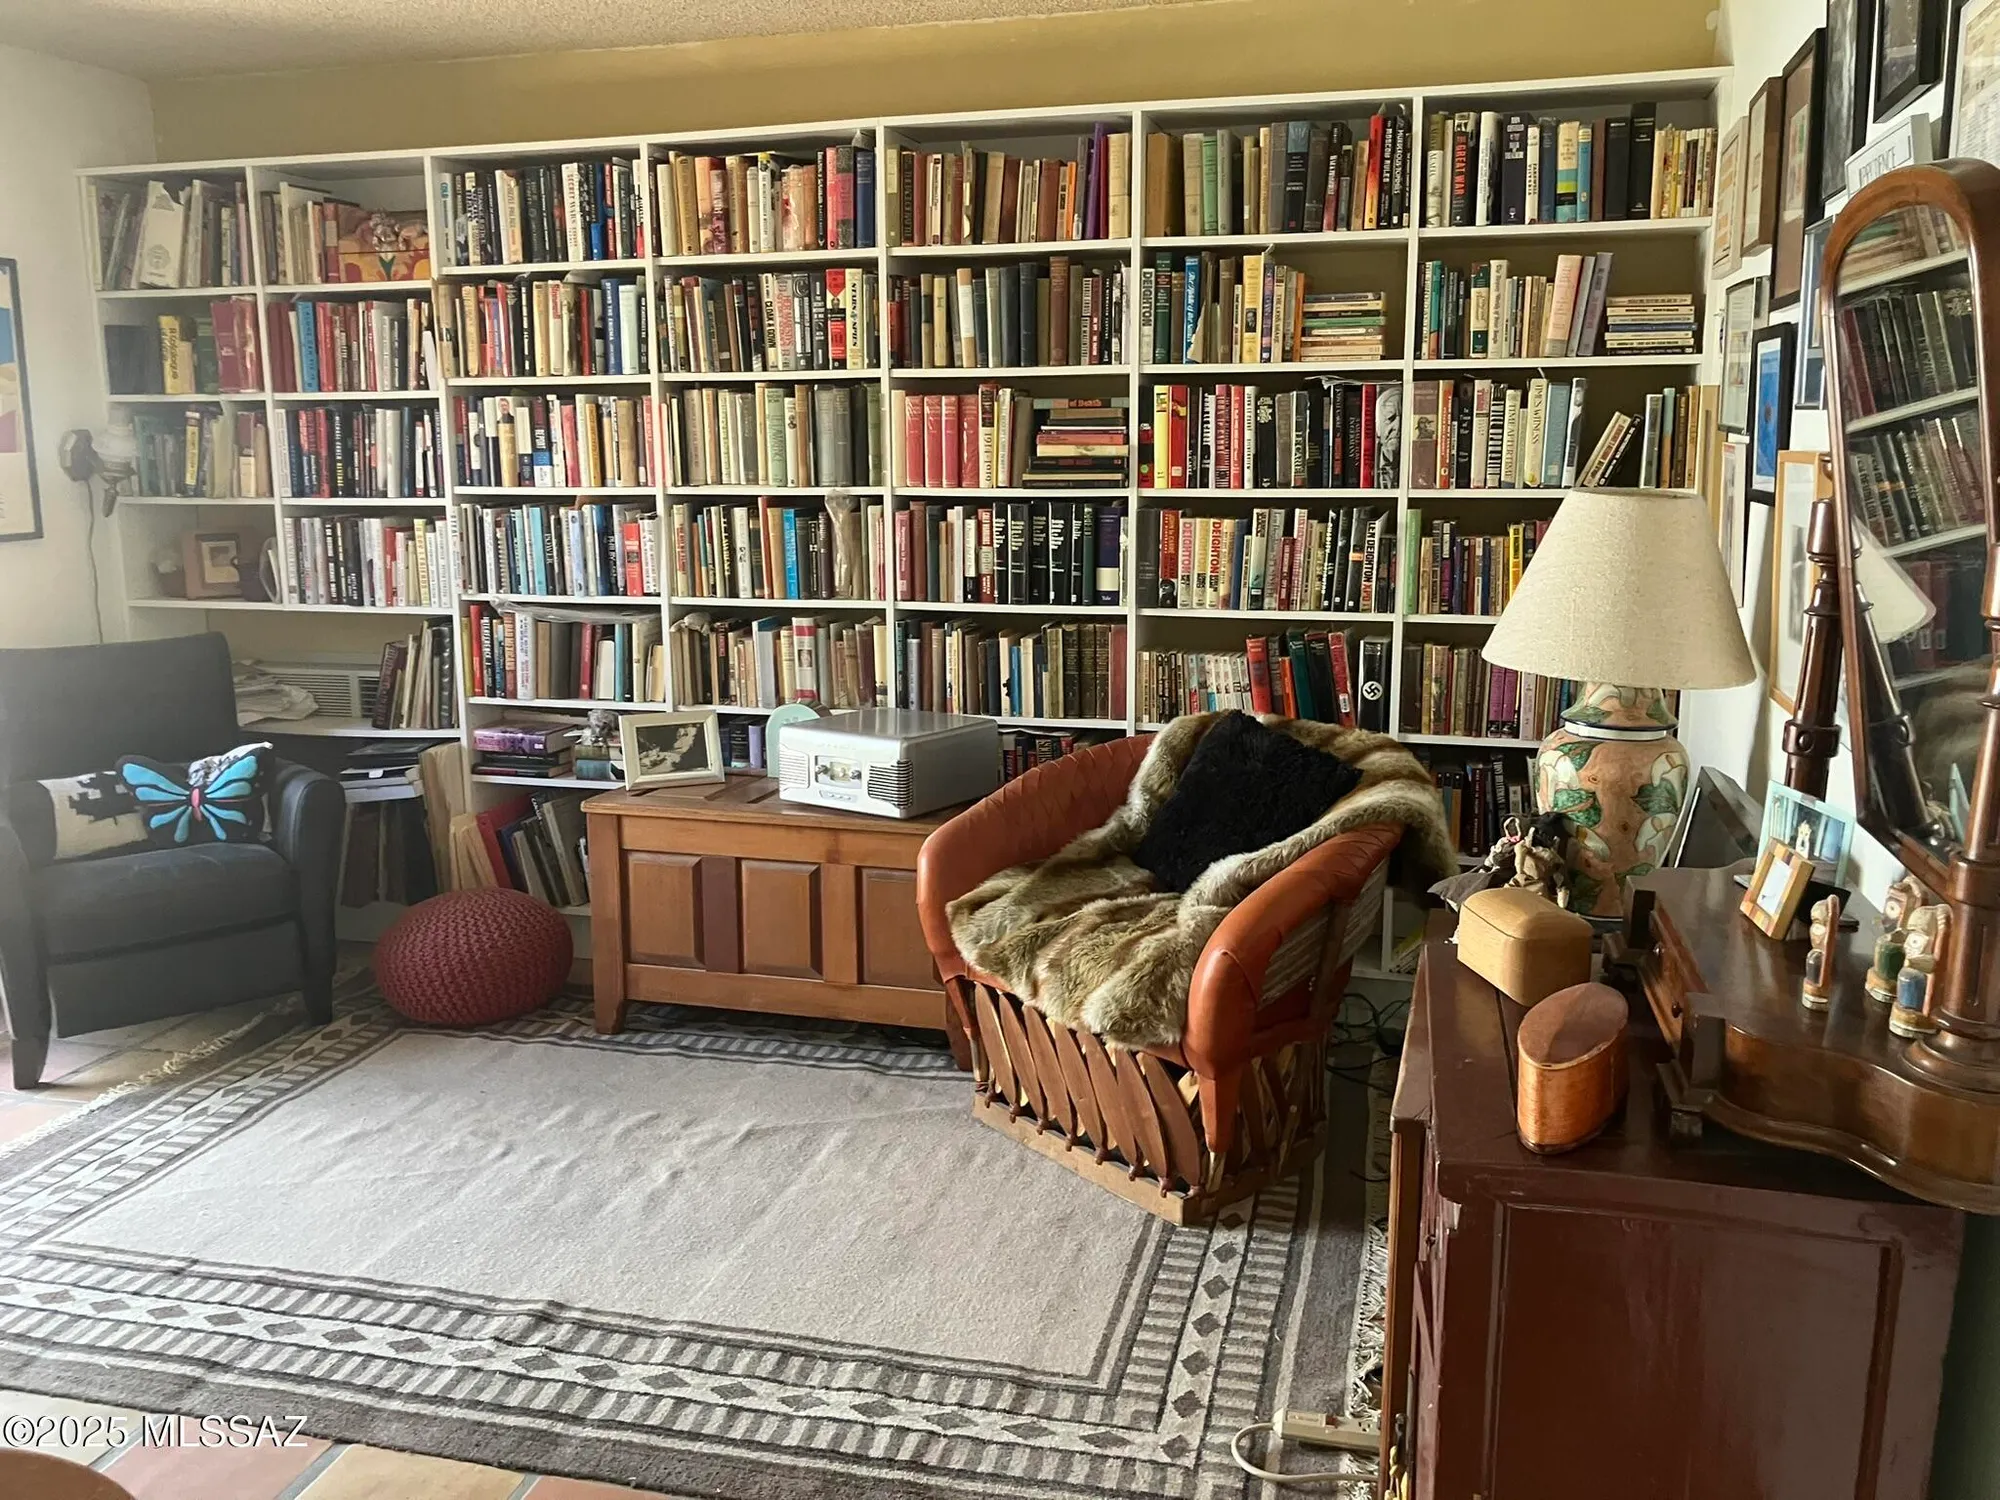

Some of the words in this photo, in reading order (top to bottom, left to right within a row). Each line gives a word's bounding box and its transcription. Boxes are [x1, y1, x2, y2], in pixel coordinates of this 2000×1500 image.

[1455, 144, 1467, 172] GREAT
[1454, 174, 1467, 195] WAR
[1143, 271, 1154, 327] DEIGHTON
[535, 429, 547, 449] REPORT
[1367, 522, 1377, 539] LEN
[545, 534, 554, 565] POWER
[1181, 522, 1193, 573] DEIGHTON
[1210, 521, 1222, 574] DEIGHTON
[1363, 540, 1375, 583] DEIGHTON
[1362, 584, 1373, 602] XPD
